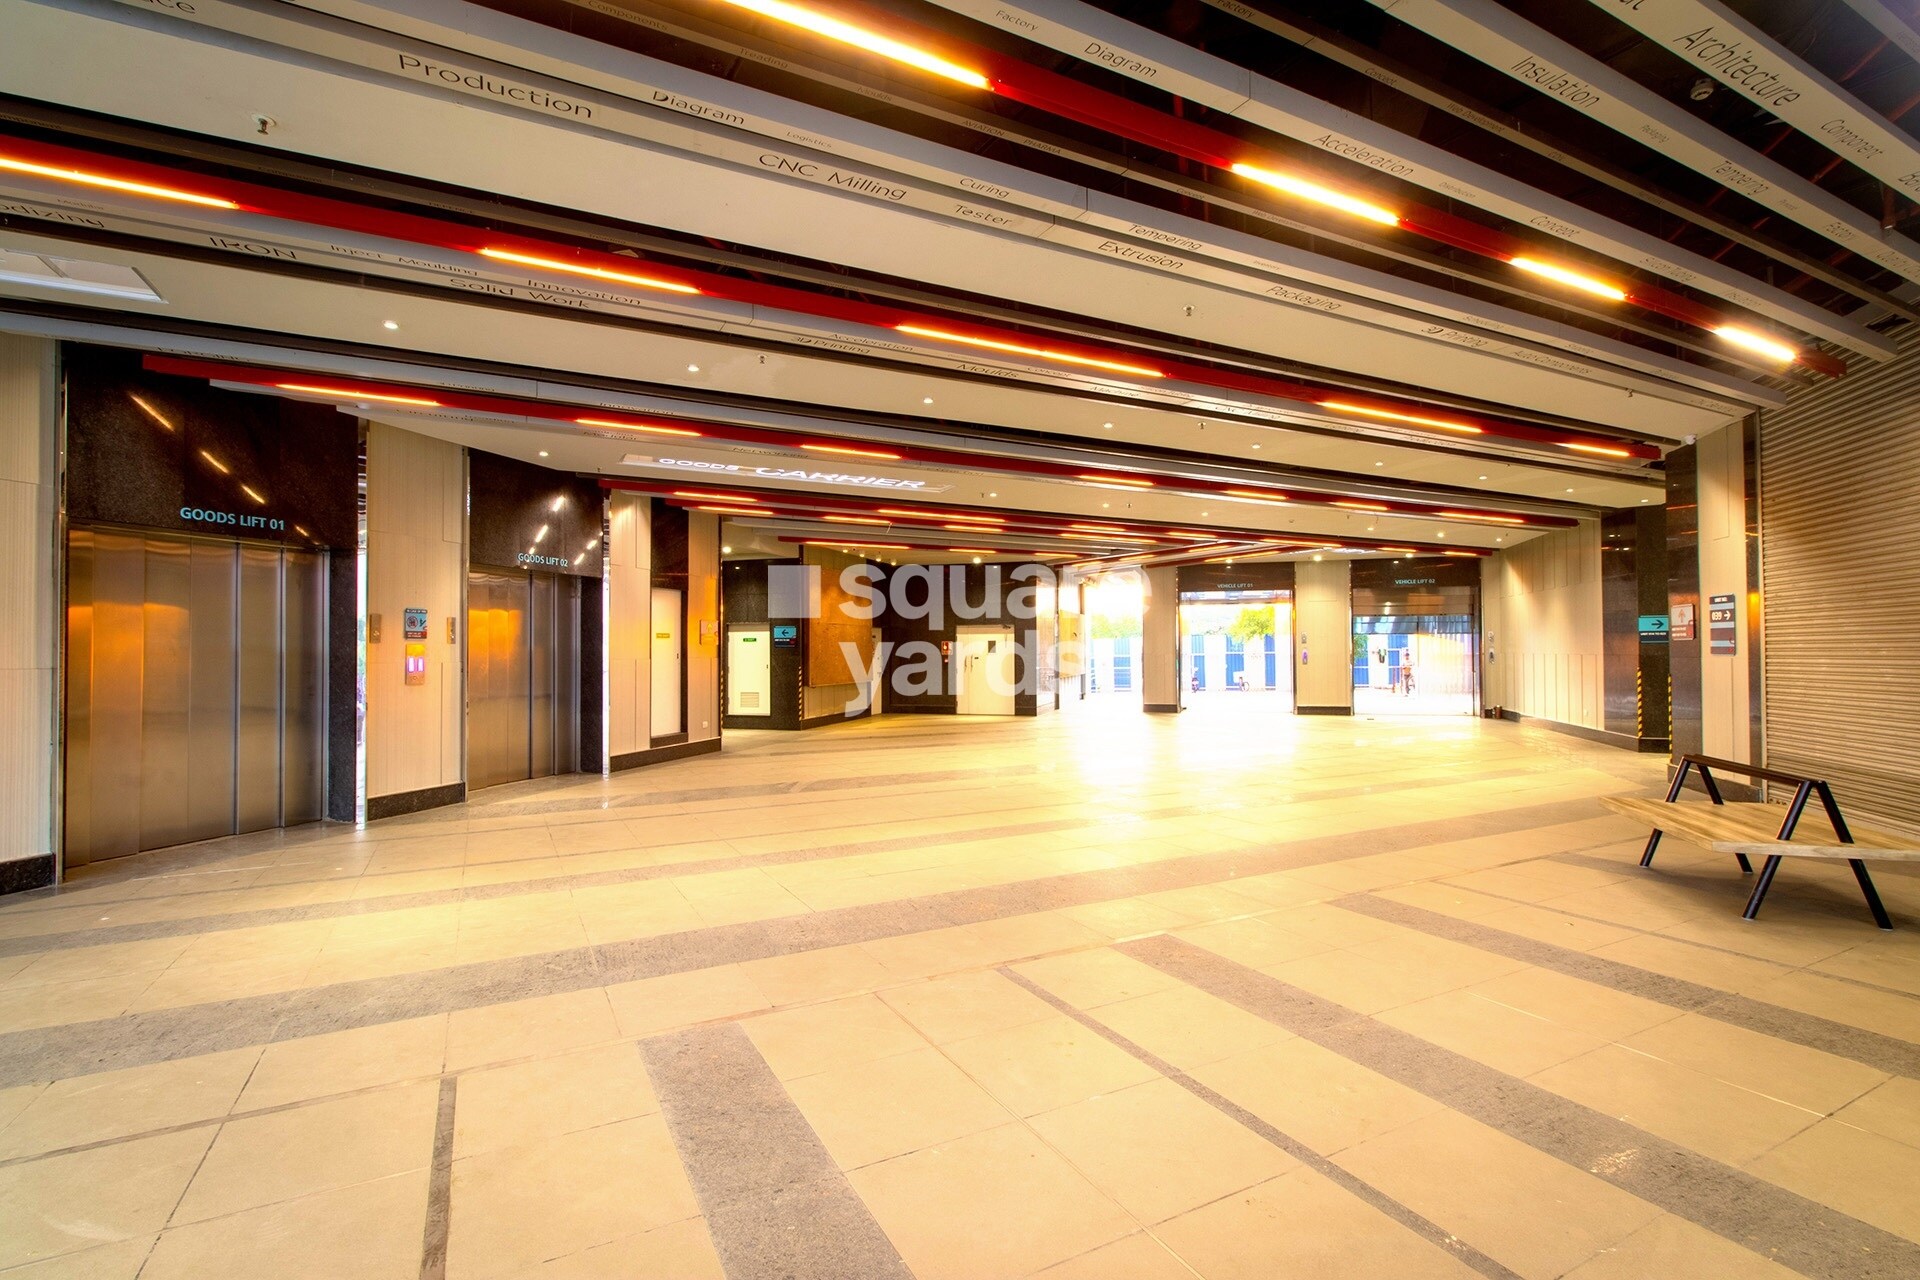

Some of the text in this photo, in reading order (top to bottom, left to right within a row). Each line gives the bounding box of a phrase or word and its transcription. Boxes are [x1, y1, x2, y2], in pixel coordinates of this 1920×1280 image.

[588, 0, 668, 32] Components
[995, 9, 1040, 32] Factory
[1083, 41, 1158, 78] Diagram
[1673, 26, 1800, 107] Architecture
[398, 53, 593, 119] Production
[1511, 55, 1600, 109] Insulation
[652, 90, 745, 125] Diagram
[786, 130, 832, 149] Logistics
[962, 119, 1005, 137] AVIATION
[1820, 118, 1884, 159] Component
[1023, 138, 1062, 155] PHARMA
[1313, 132, 1415, 177] Acceleration
[758, 153, 907, 201] CNC Milling
[960, 178, 1010, 200] Curing
[955, 204, 1013, 227] Tester
[208, 237, 298, 261] IRON
[1129, 223, 1203, 252] Tempering
[330, 244, 479, 277] Inject Moulding
[1097, 240, 1184, 271] Extrusion
[450, 278, 590, 309] Solid Work
[528, 279, 641, 307] Innovation
[1266, 285, 1343, 312] Packaging
[812, 339, 872, 355] Printing
[829, 332, 914, 353] Acceleration
[957, 363, 1019, 380] Moulds
[657, 457, 741, 472] GOODS
[754, 466, 926, 491] CARRIER
[180, 507, 285, 531] GOODS LIFT 01
[518, 552, 569, 567] GOODS LIFT 02
